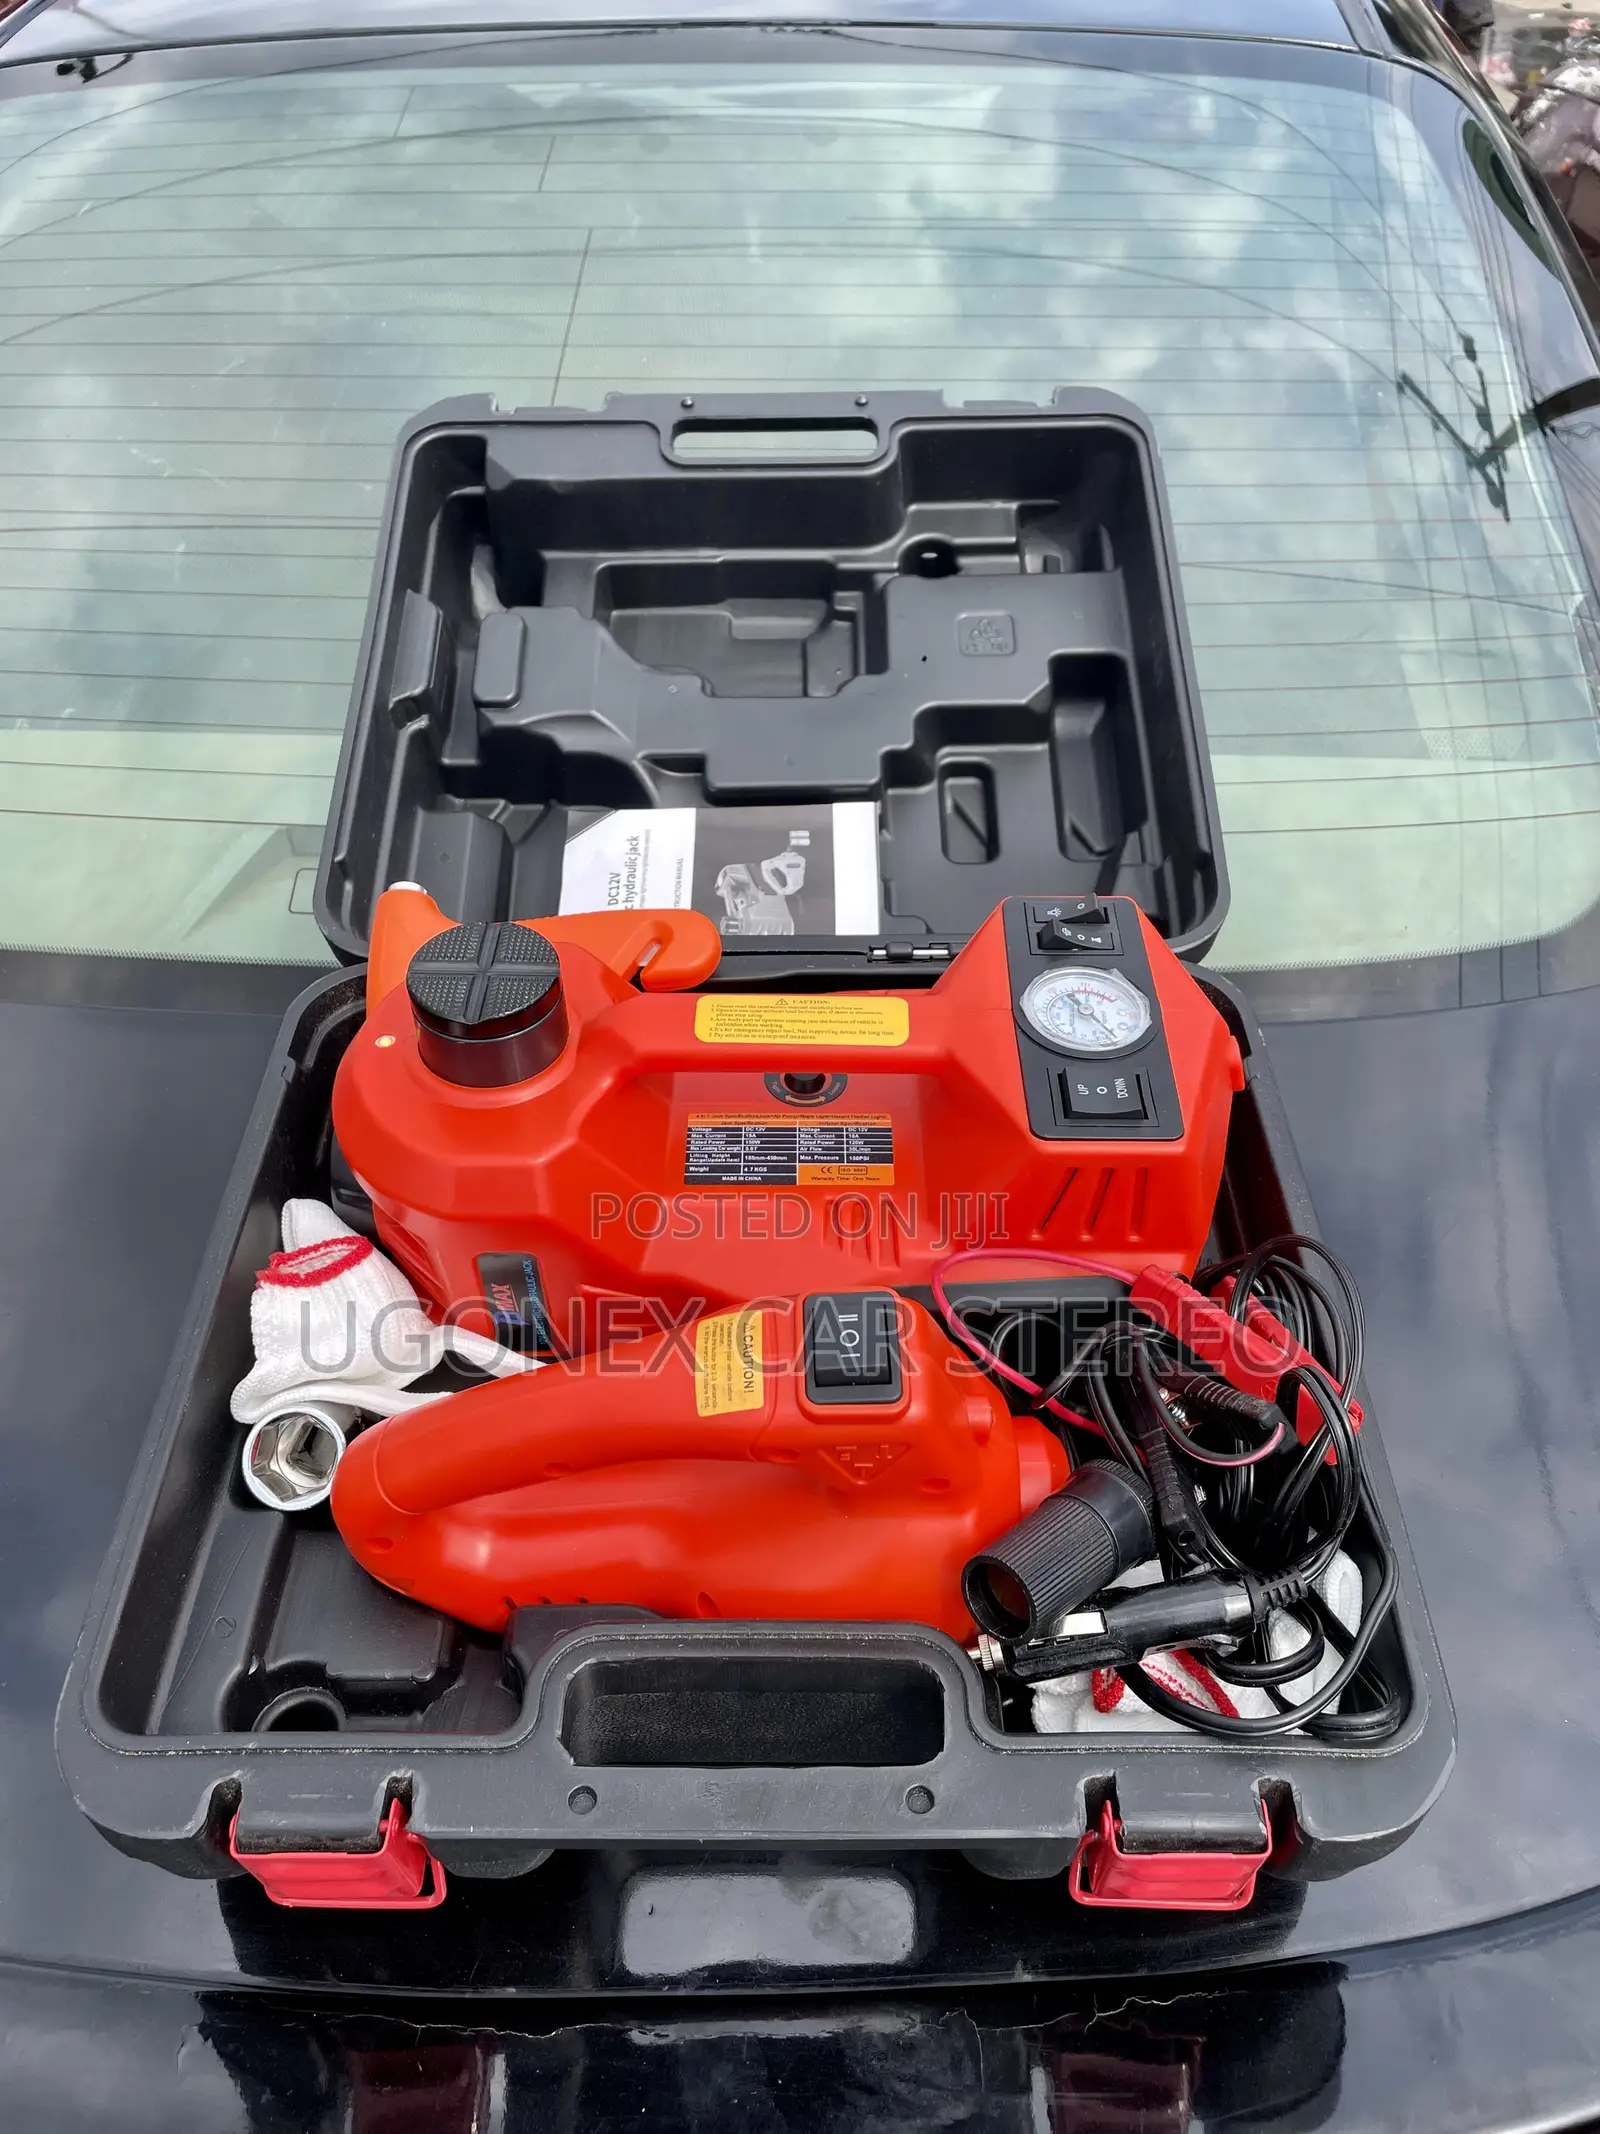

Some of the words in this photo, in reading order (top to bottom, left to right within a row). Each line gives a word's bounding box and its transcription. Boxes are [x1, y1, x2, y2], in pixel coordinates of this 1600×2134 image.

[624, 836, 641, 856] jack
[608, 872, 620, 906] DC12V
[622, 856, 638, 904] hydraulic
[674, 880, 682, 908] TRUCTION
[1077, 1084, 1089, 1095] UP
[1114, 1077, 1128, 1098] DOWN
[742, 1335, 754, 1394] CAUTION!
